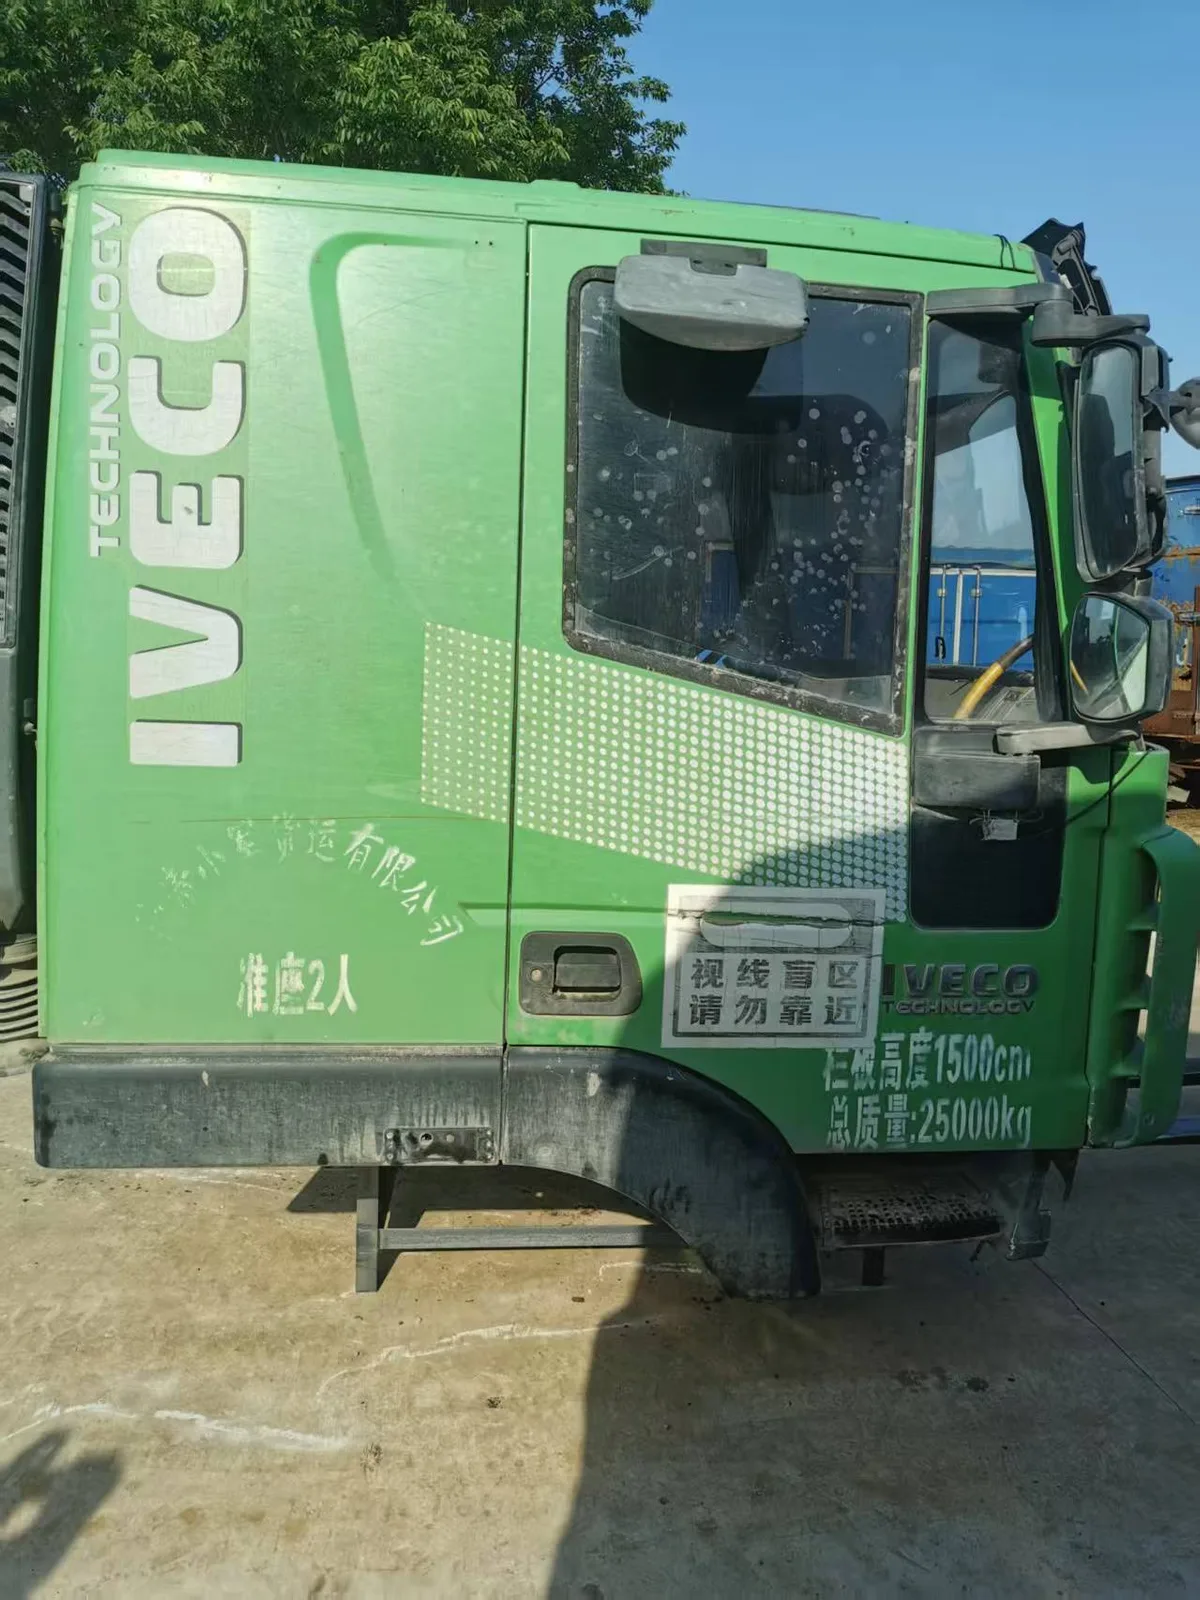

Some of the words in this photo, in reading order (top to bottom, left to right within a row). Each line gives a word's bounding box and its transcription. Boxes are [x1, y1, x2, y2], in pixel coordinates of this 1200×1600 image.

[90, 202, 122, 558] TECHNOLOGY
[128, 206, 248, 767] IVECO
[691, 957, 860, 990] 视线盲区
[882, 963, 1039, 997] IVECO
[688, 994, 858, 1026] 请勿靠近
[882, 1000, 1035, 1015] TECHNOLOGY
